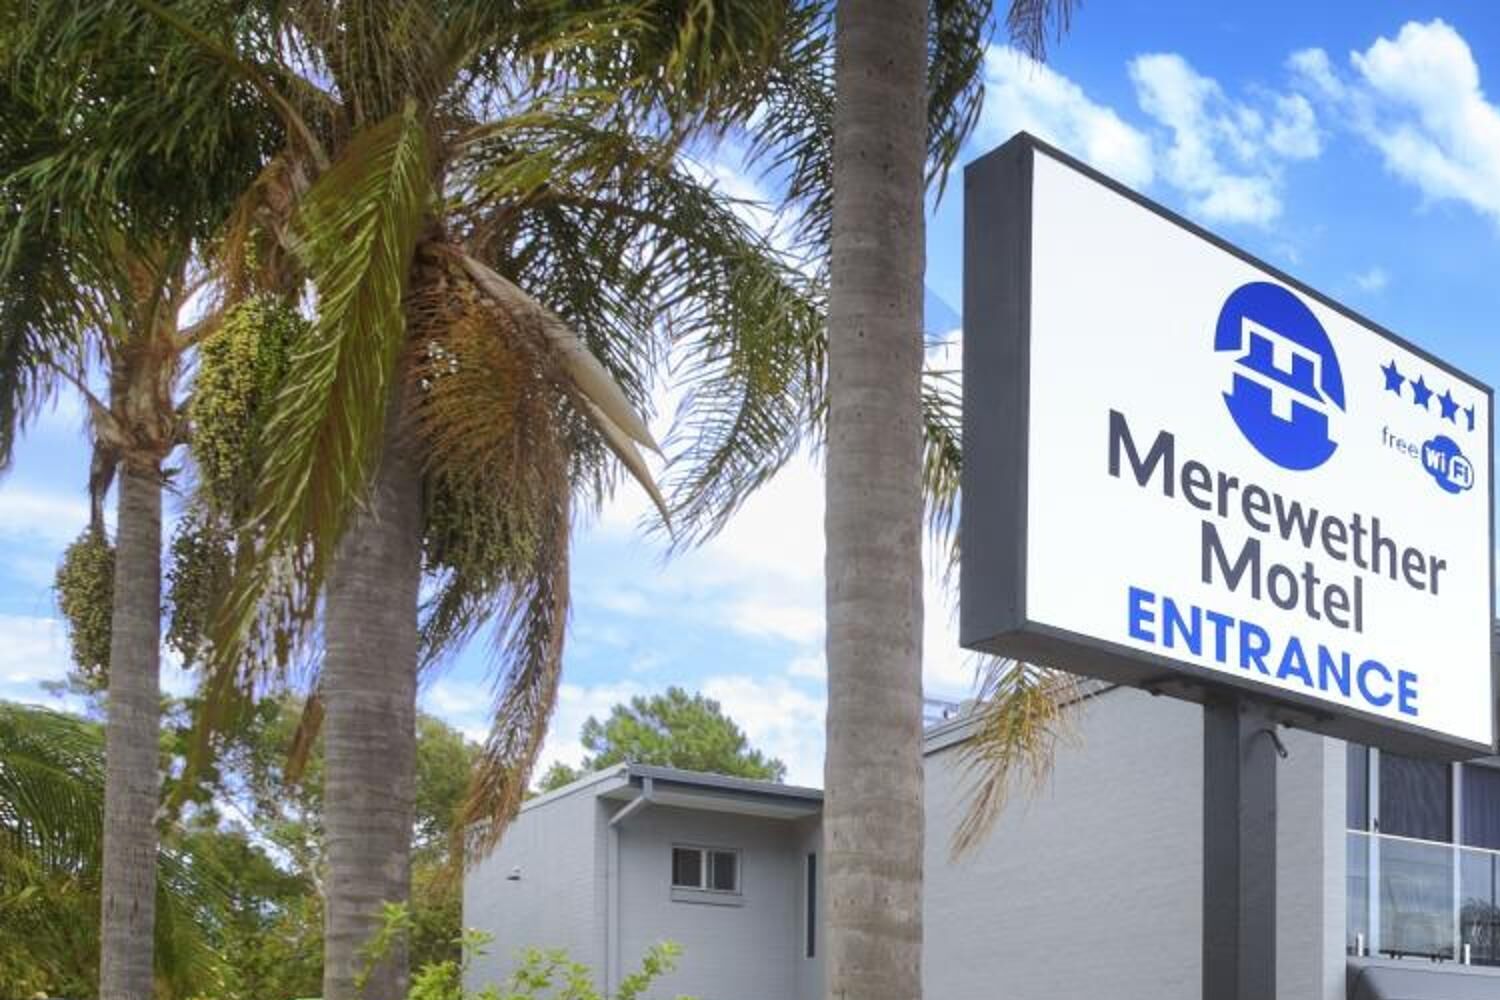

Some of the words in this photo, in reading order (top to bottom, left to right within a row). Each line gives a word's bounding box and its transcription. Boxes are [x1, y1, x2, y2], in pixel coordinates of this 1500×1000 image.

[1108, 408, 1447, 596] Merewether
[1382, 425, 1419, 459] free
[1201, 519, 1363, 633] Motel
[1127, 585, 1419, 717] ENTRANCE
